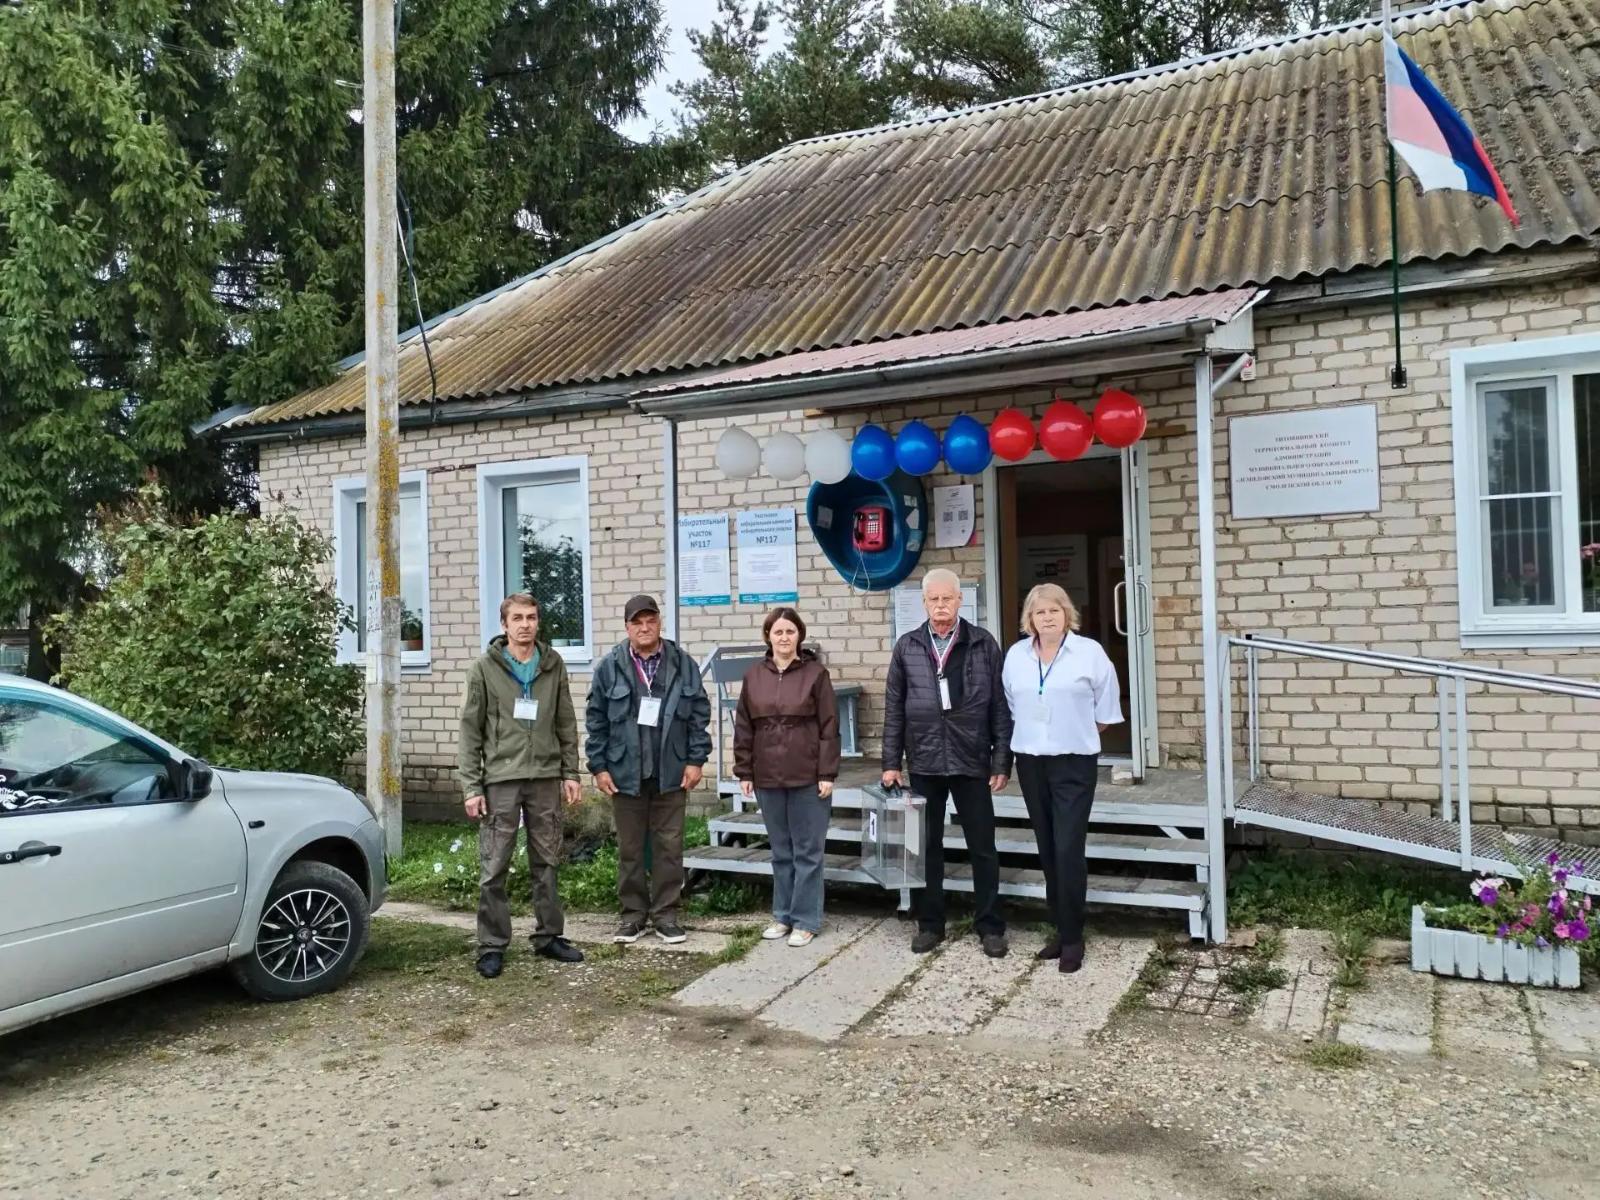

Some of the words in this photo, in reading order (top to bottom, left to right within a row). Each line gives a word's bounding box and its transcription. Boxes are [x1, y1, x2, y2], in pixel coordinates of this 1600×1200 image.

[688, 530, 712, 538] участок
[756, 535, 778, 544] №117
[690, 540, 711, 548] №117
